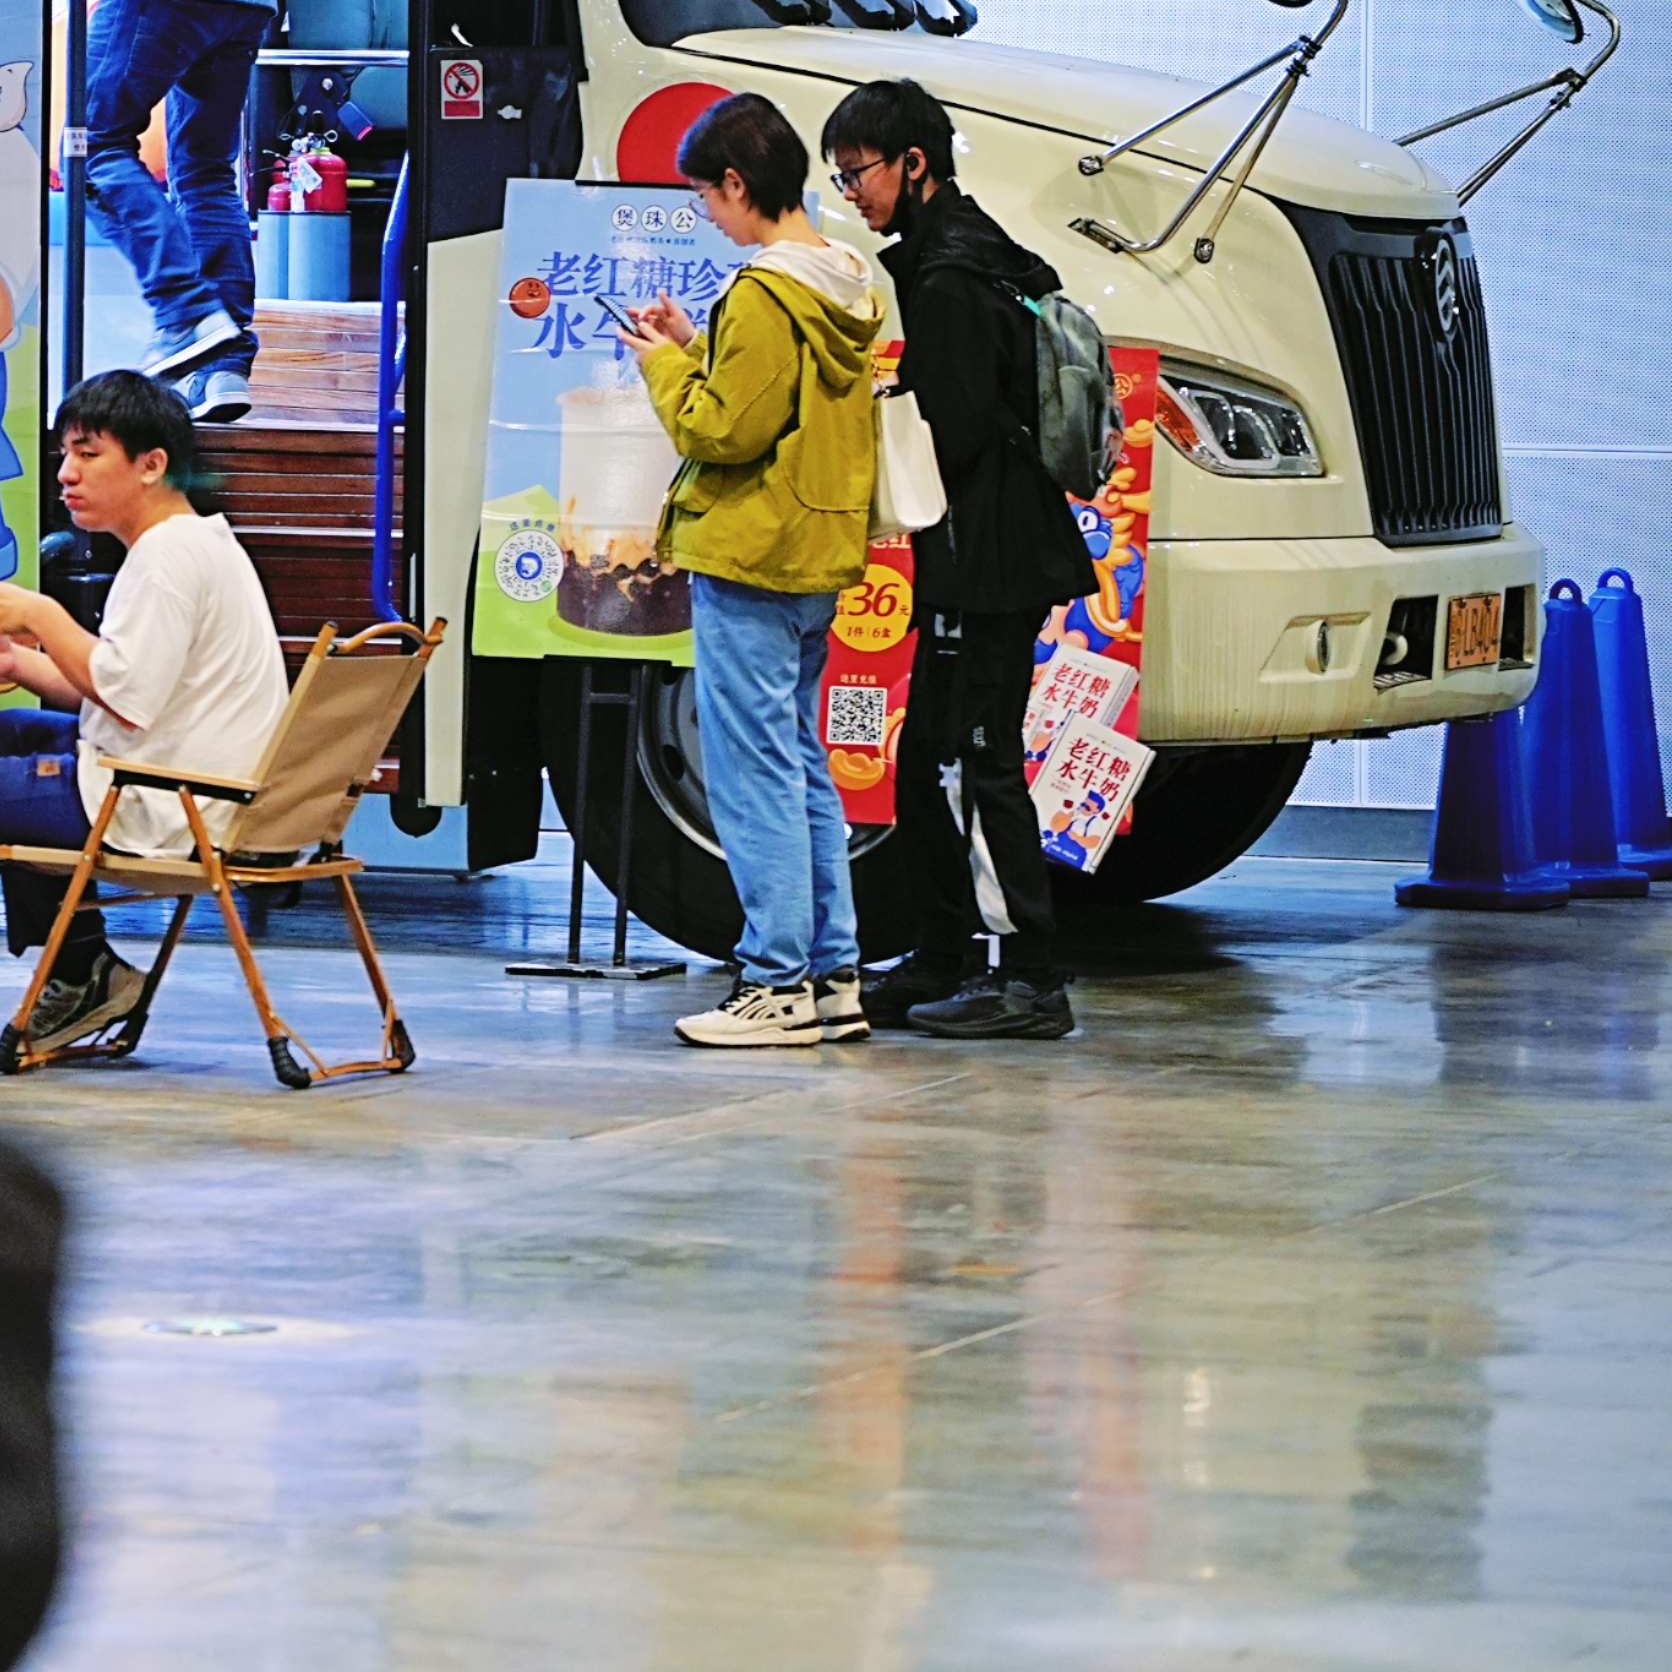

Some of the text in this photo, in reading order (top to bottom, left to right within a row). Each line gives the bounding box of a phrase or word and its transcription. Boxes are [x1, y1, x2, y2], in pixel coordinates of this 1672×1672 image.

[617, 208, 694, 229] 煲珠公
[536, 251, 746, 302] 老红糖珍
[1054, 662, 1110, 699] 老红糖
[1041, 683, 1100, 719] 水牛奶
[1068, 737, 1131, 781] 老红糖
[1056, 759, 1121, 803] 水牛奶
